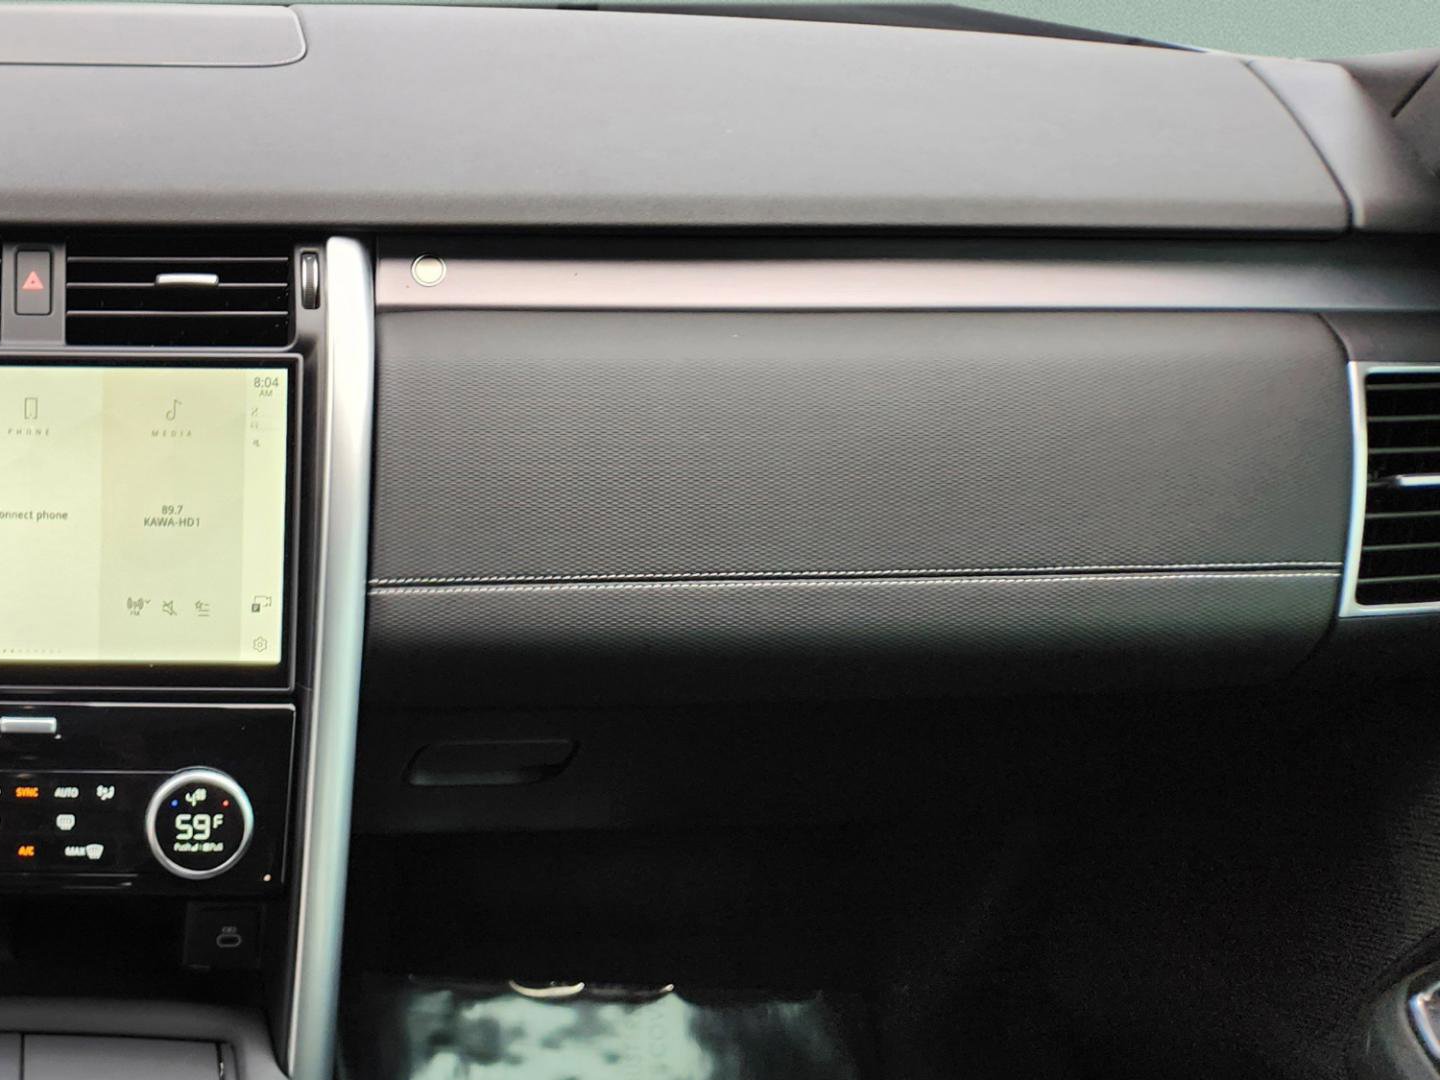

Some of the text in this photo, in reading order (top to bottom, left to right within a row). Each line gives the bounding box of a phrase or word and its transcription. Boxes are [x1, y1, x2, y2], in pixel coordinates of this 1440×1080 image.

[253, 377, 279, 388] 8:04
[8, 428, 50, 436] PHONE
[162, 505, 183, 515] 89.7
[36, 509, 68, 522] phone
[144, 517, 200, 527] KAWA-HD1
[16, 787, 39, 797] SYNC
[54, 787, 79, 798] AUTO
[18, 846, 35, 856] A/C
